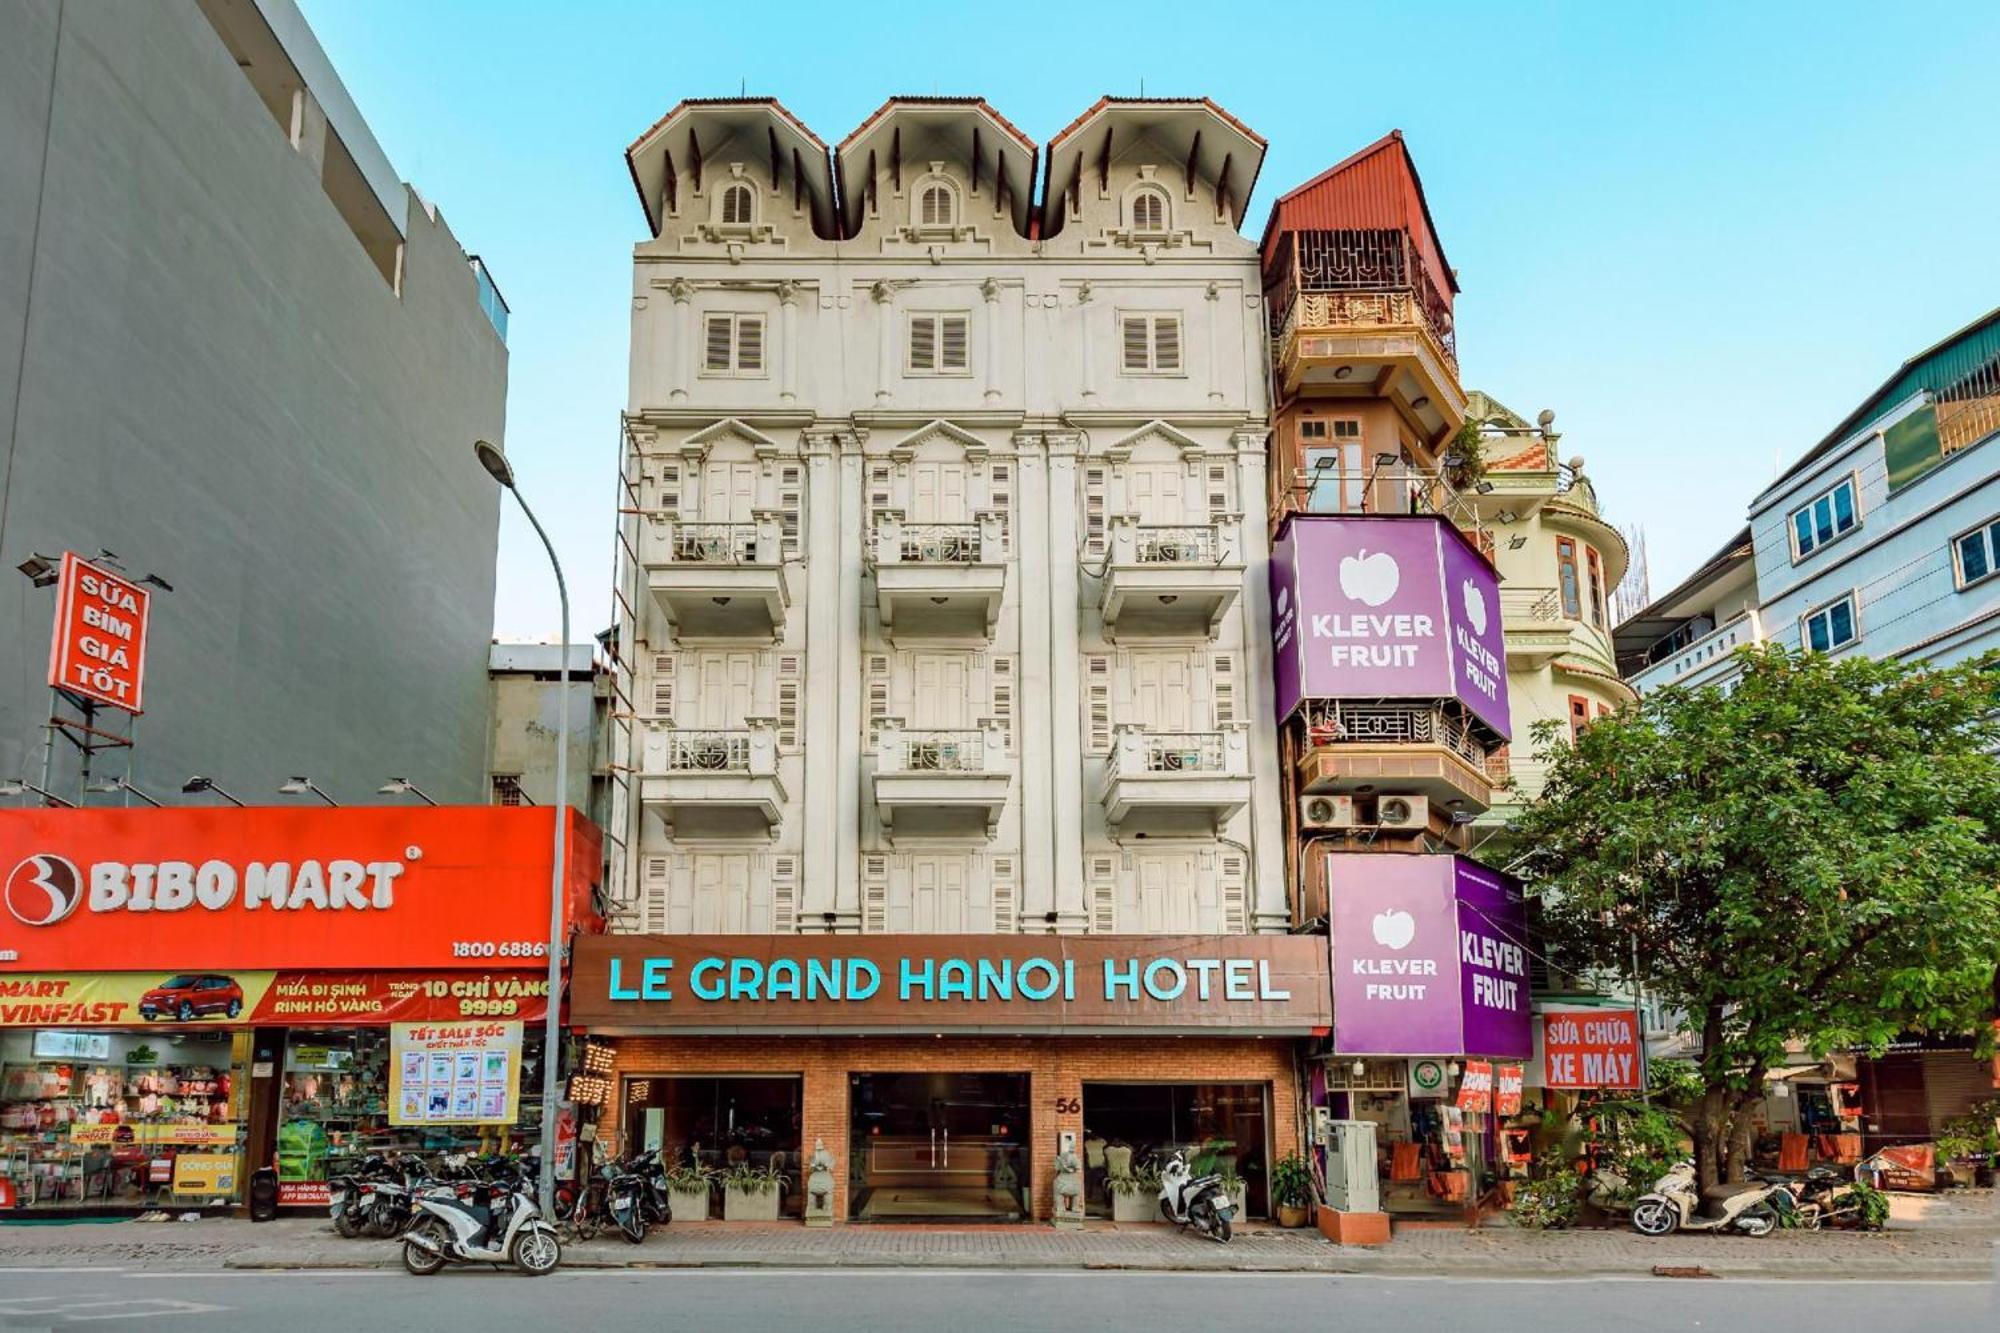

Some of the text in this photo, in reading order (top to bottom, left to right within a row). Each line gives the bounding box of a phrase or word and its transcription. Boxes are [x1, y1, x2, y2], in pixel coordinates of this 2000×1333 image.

[80, 574, 139, 615] SỮA
[1311, 614, 1435, 638] KLEVER
[79, 635, 130, 670] GIÁ
[1331, 644, 1419, 668] FRUIT
[1456, 623, 1501, 680] KLEVER
[75, 663, 131, 698] TỐT
[1466, 658, 1497, 701] FRUIT
[89, 860, 404, 912] BIBO MART
[453, 942, 495, 957] 1800
[1461, 930, 1525, 976] KLEVER
[609, 957, 1291, 1001] LE GRAND HANOI HOTEL
[1352, 959, 1439, 976] KLEVER
[0, 980, 70, 997] MART
[424, 980, 448, 997] 10
[1366, 984, 1427, 1001] FRUIT
[1473, 973, 1518, 1011] FRUIT
[0, 1002, 128, 1022] VINFAST
[275, 1001, 312, 1013] RINH
[340, 997, 383, 1013] VÀNG
[459, 999, 518, 1016] 9999
[438, 1026, 473, 1040] SALE
[1550, 1047, 1633, 1084] XE MÁY
[1055, 1097, 1081, 1114] 56
